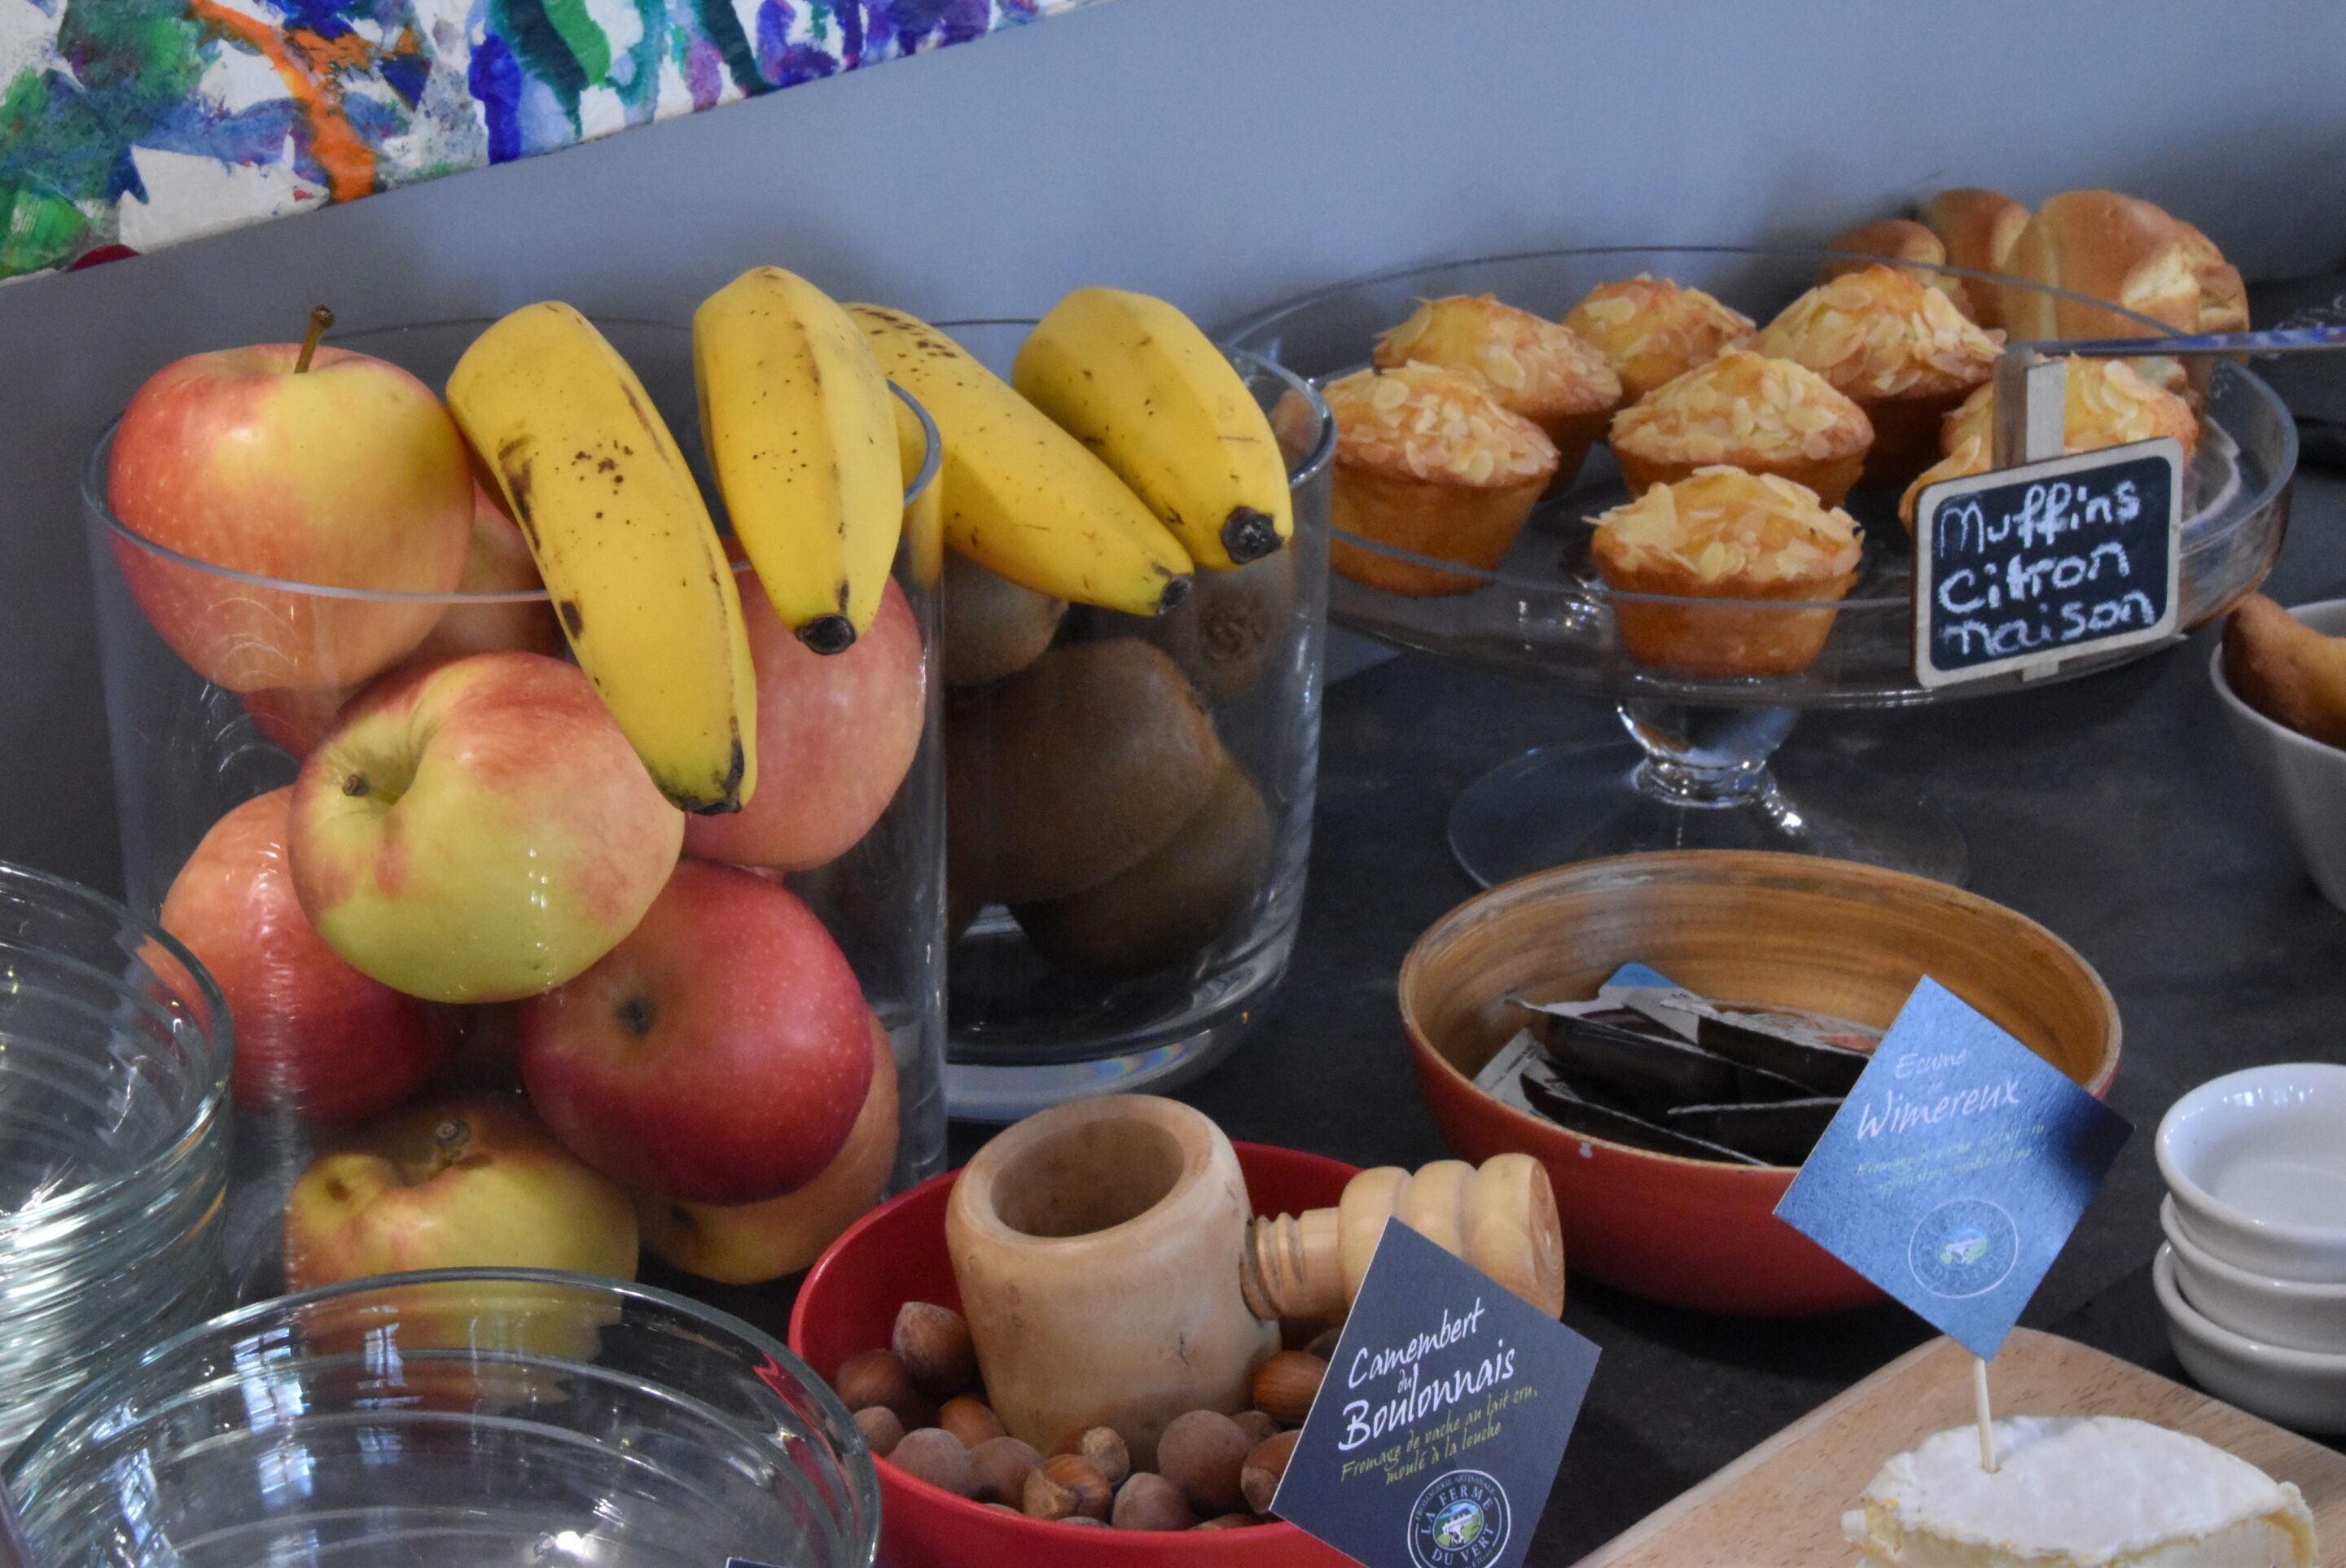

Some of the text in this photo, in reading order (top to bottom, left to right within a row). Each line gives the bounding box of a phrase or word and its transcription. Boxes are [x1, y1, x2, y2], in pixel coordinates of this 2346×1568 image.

[1940, 481, 2141, 557] Muffins
[1939, 541, 2130, 614] Citron
[1856, 1077, 2022, 1141] Wimereux
[1347, 1295, 1486, 1390] Camembert
[1337, 1338, 1517, 1452] Boulonnais
[1397, 1369, 1413, 1393] du
[1340, 1443, 1402, 1483] Fromage
[1405, 1428, 1421, 1453] de
[1424, 1408, 1461, 1444] vache
[1465, 1408, 1482, 1426] au
[1486, 1389, 1510, 1417] lait
[1444, 1434, 1458, 1460] la
[1462, 1413, 1502, 1451] louche
[1420, 1484, 1494, 1535] LA FERME
[1431, 1548, 1454, 1567] DU
[1459, 1523, 1495, 1564] VERT
